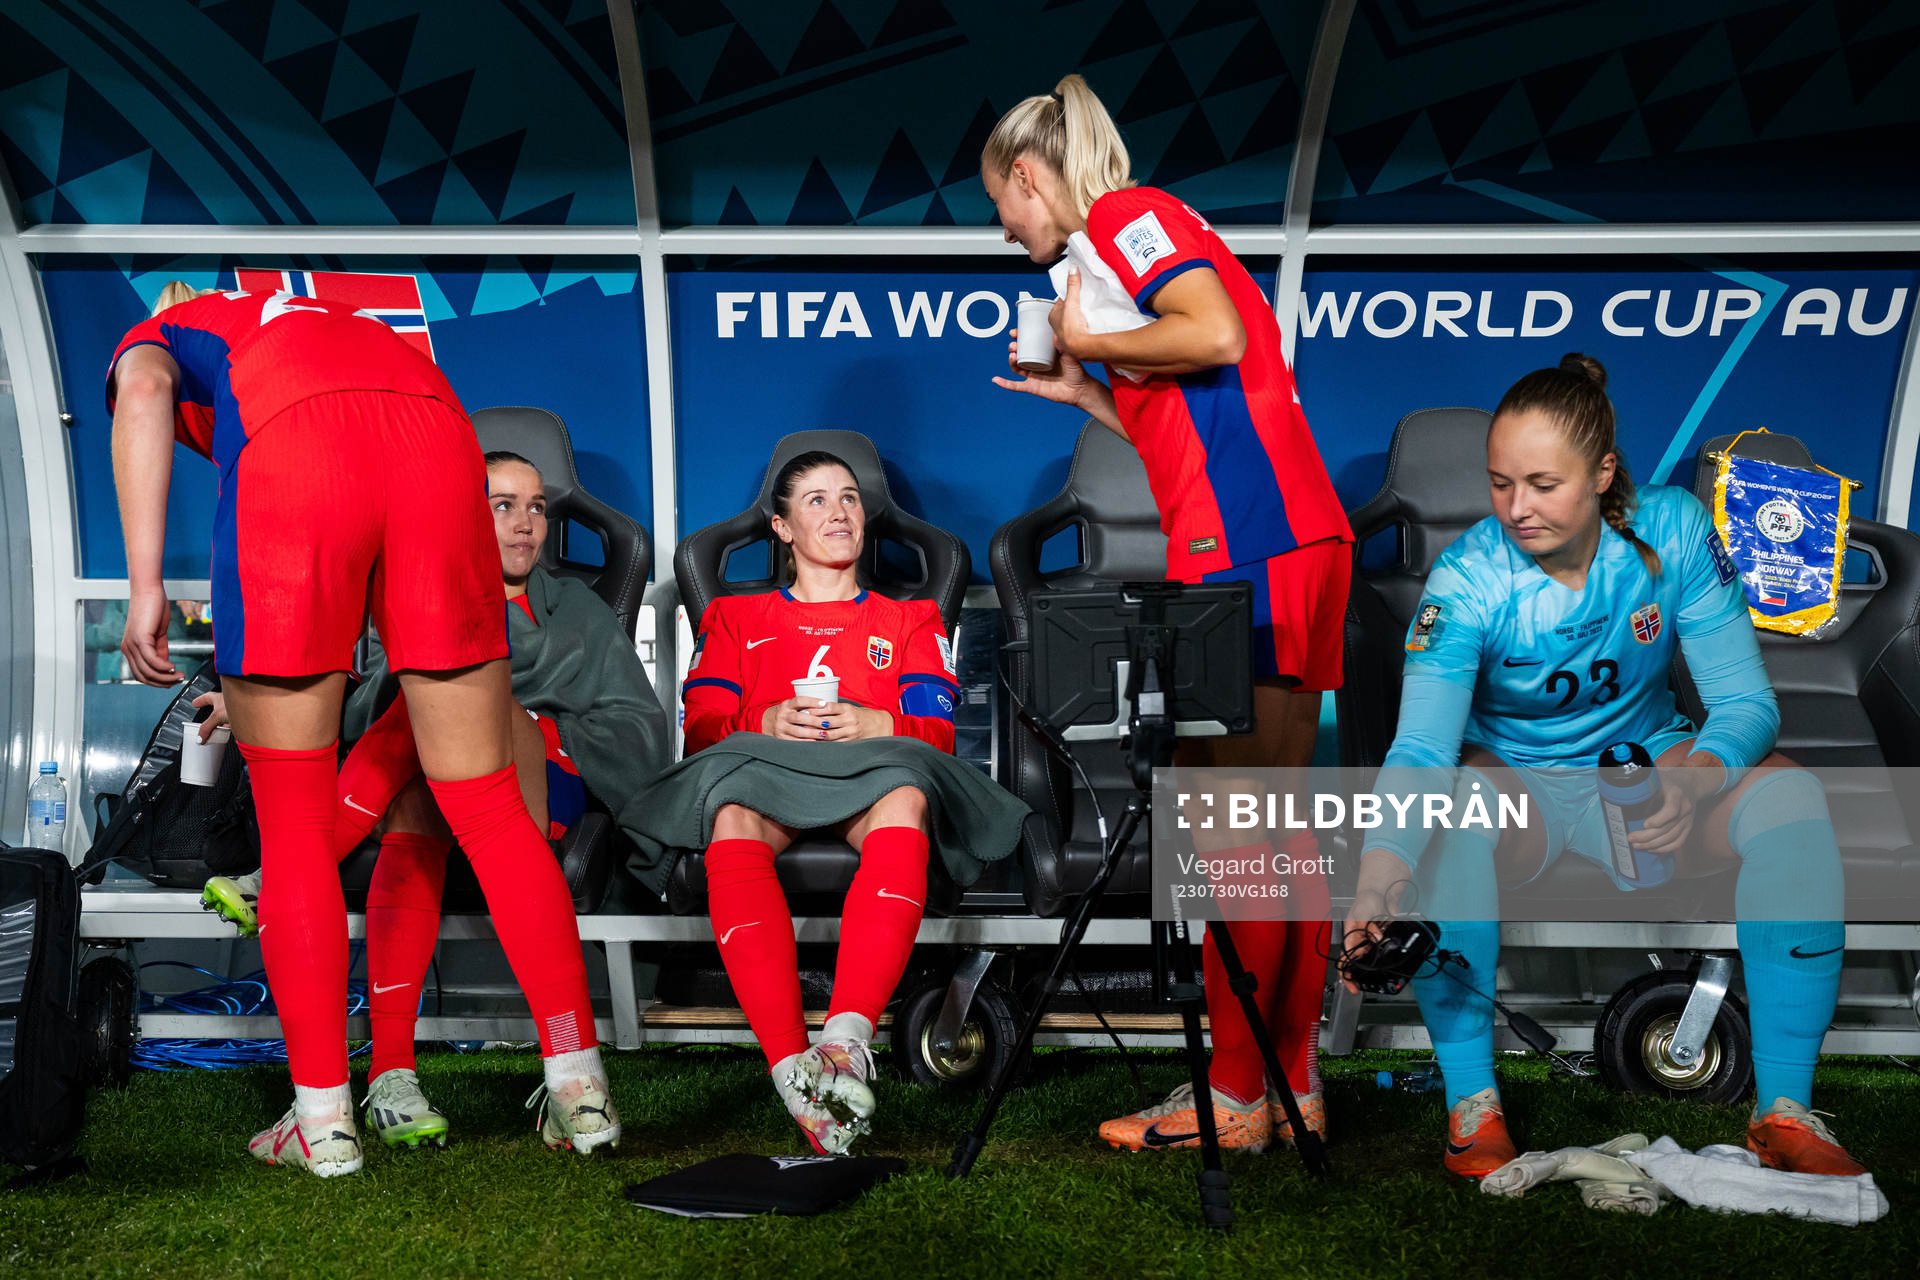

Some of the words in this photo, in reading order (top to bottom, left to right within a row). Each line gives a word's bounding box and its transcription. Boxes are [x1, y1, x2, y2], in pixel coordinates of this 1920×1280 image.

[1129, 230, 1154, 250] UNITES
[716, 291, 872, 338] FIFA
[888, 290, 1032, 338] WO
[1298, 290, 1573, 338] WORLD
[1600, 289, 1762, 338] CUP
[1770, 523, 1793, 532] PFF
[1751, 548, 1805, 564] PHILIPPINES
[1758, 564, 1796, 576] NORWAY
[807, 645, 834, 680] 6
[1546, 659, 1620, 710] 23
